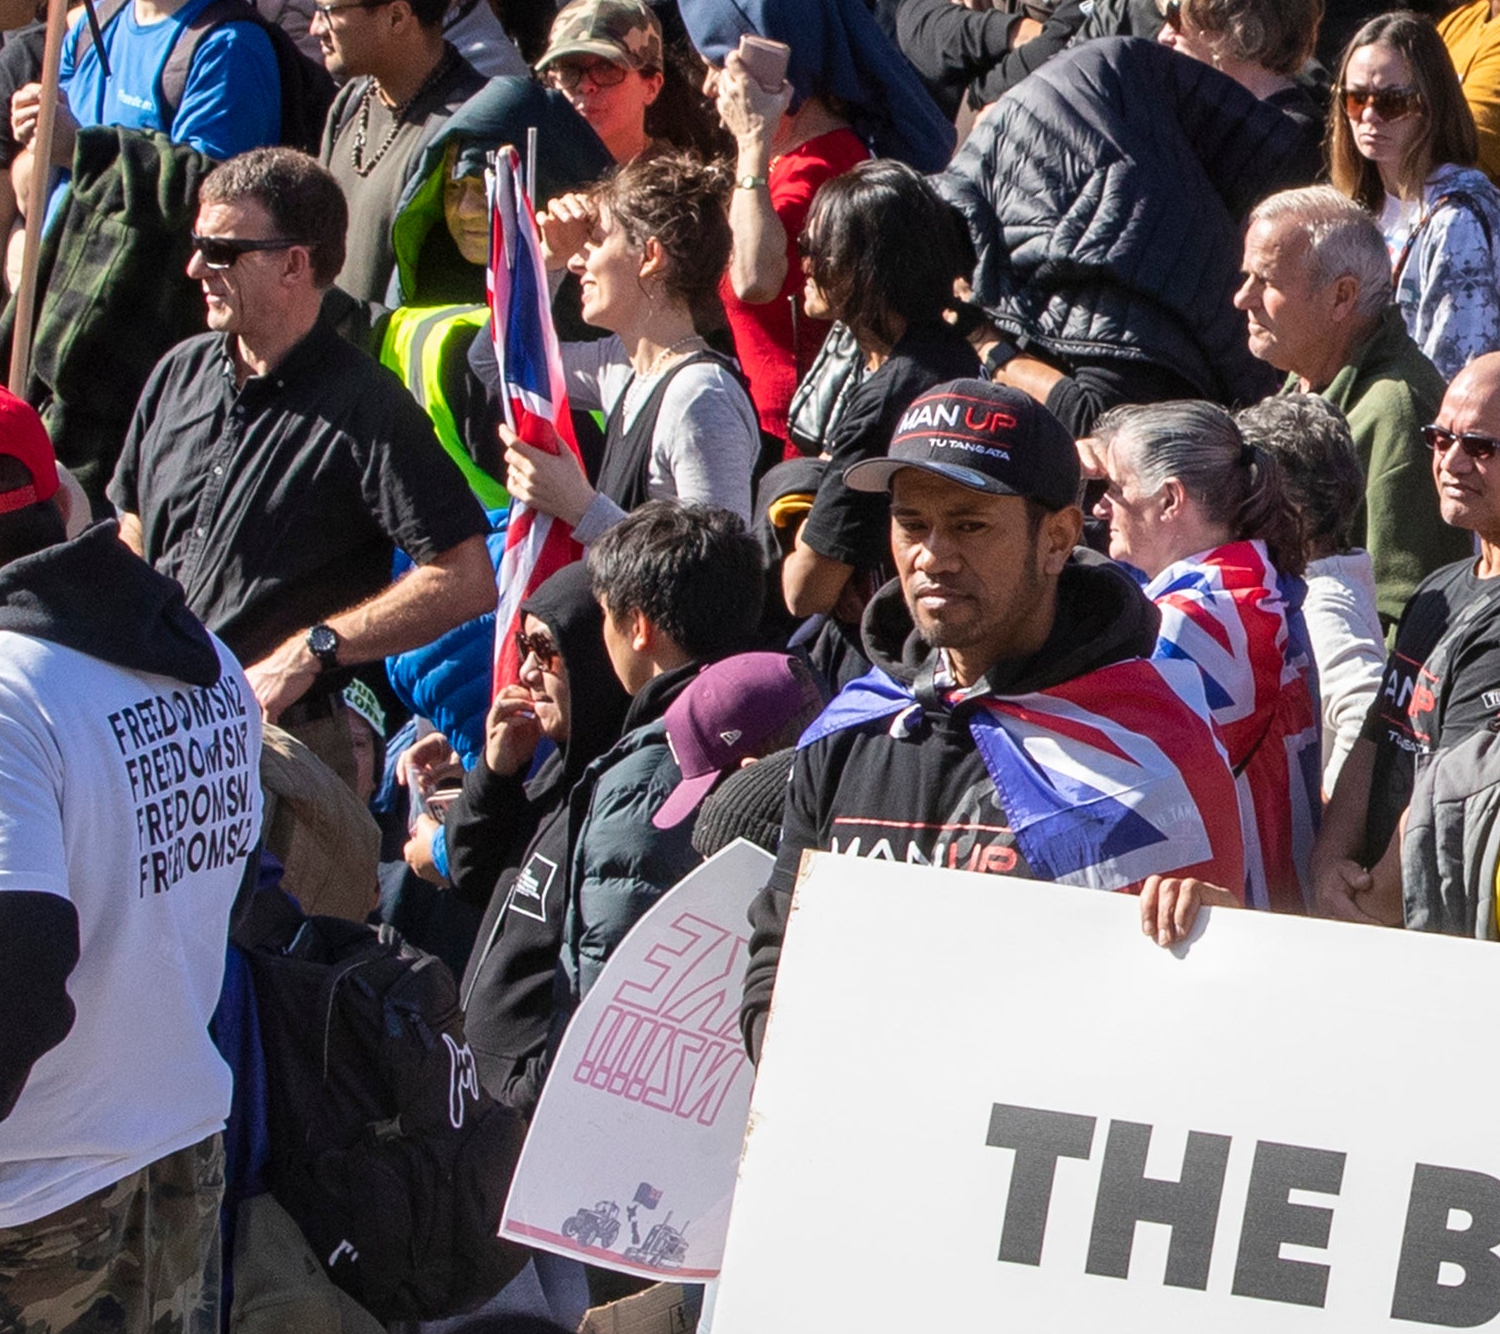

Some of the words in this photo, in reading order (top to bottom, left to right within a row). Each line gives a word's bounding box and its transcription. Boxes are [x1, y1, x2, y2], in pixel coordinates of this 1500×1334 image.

[898, 404, 961, 435] MAN
[964, 406, 1018, 435] UP
[986, 1113, 1347, 1309] THE
